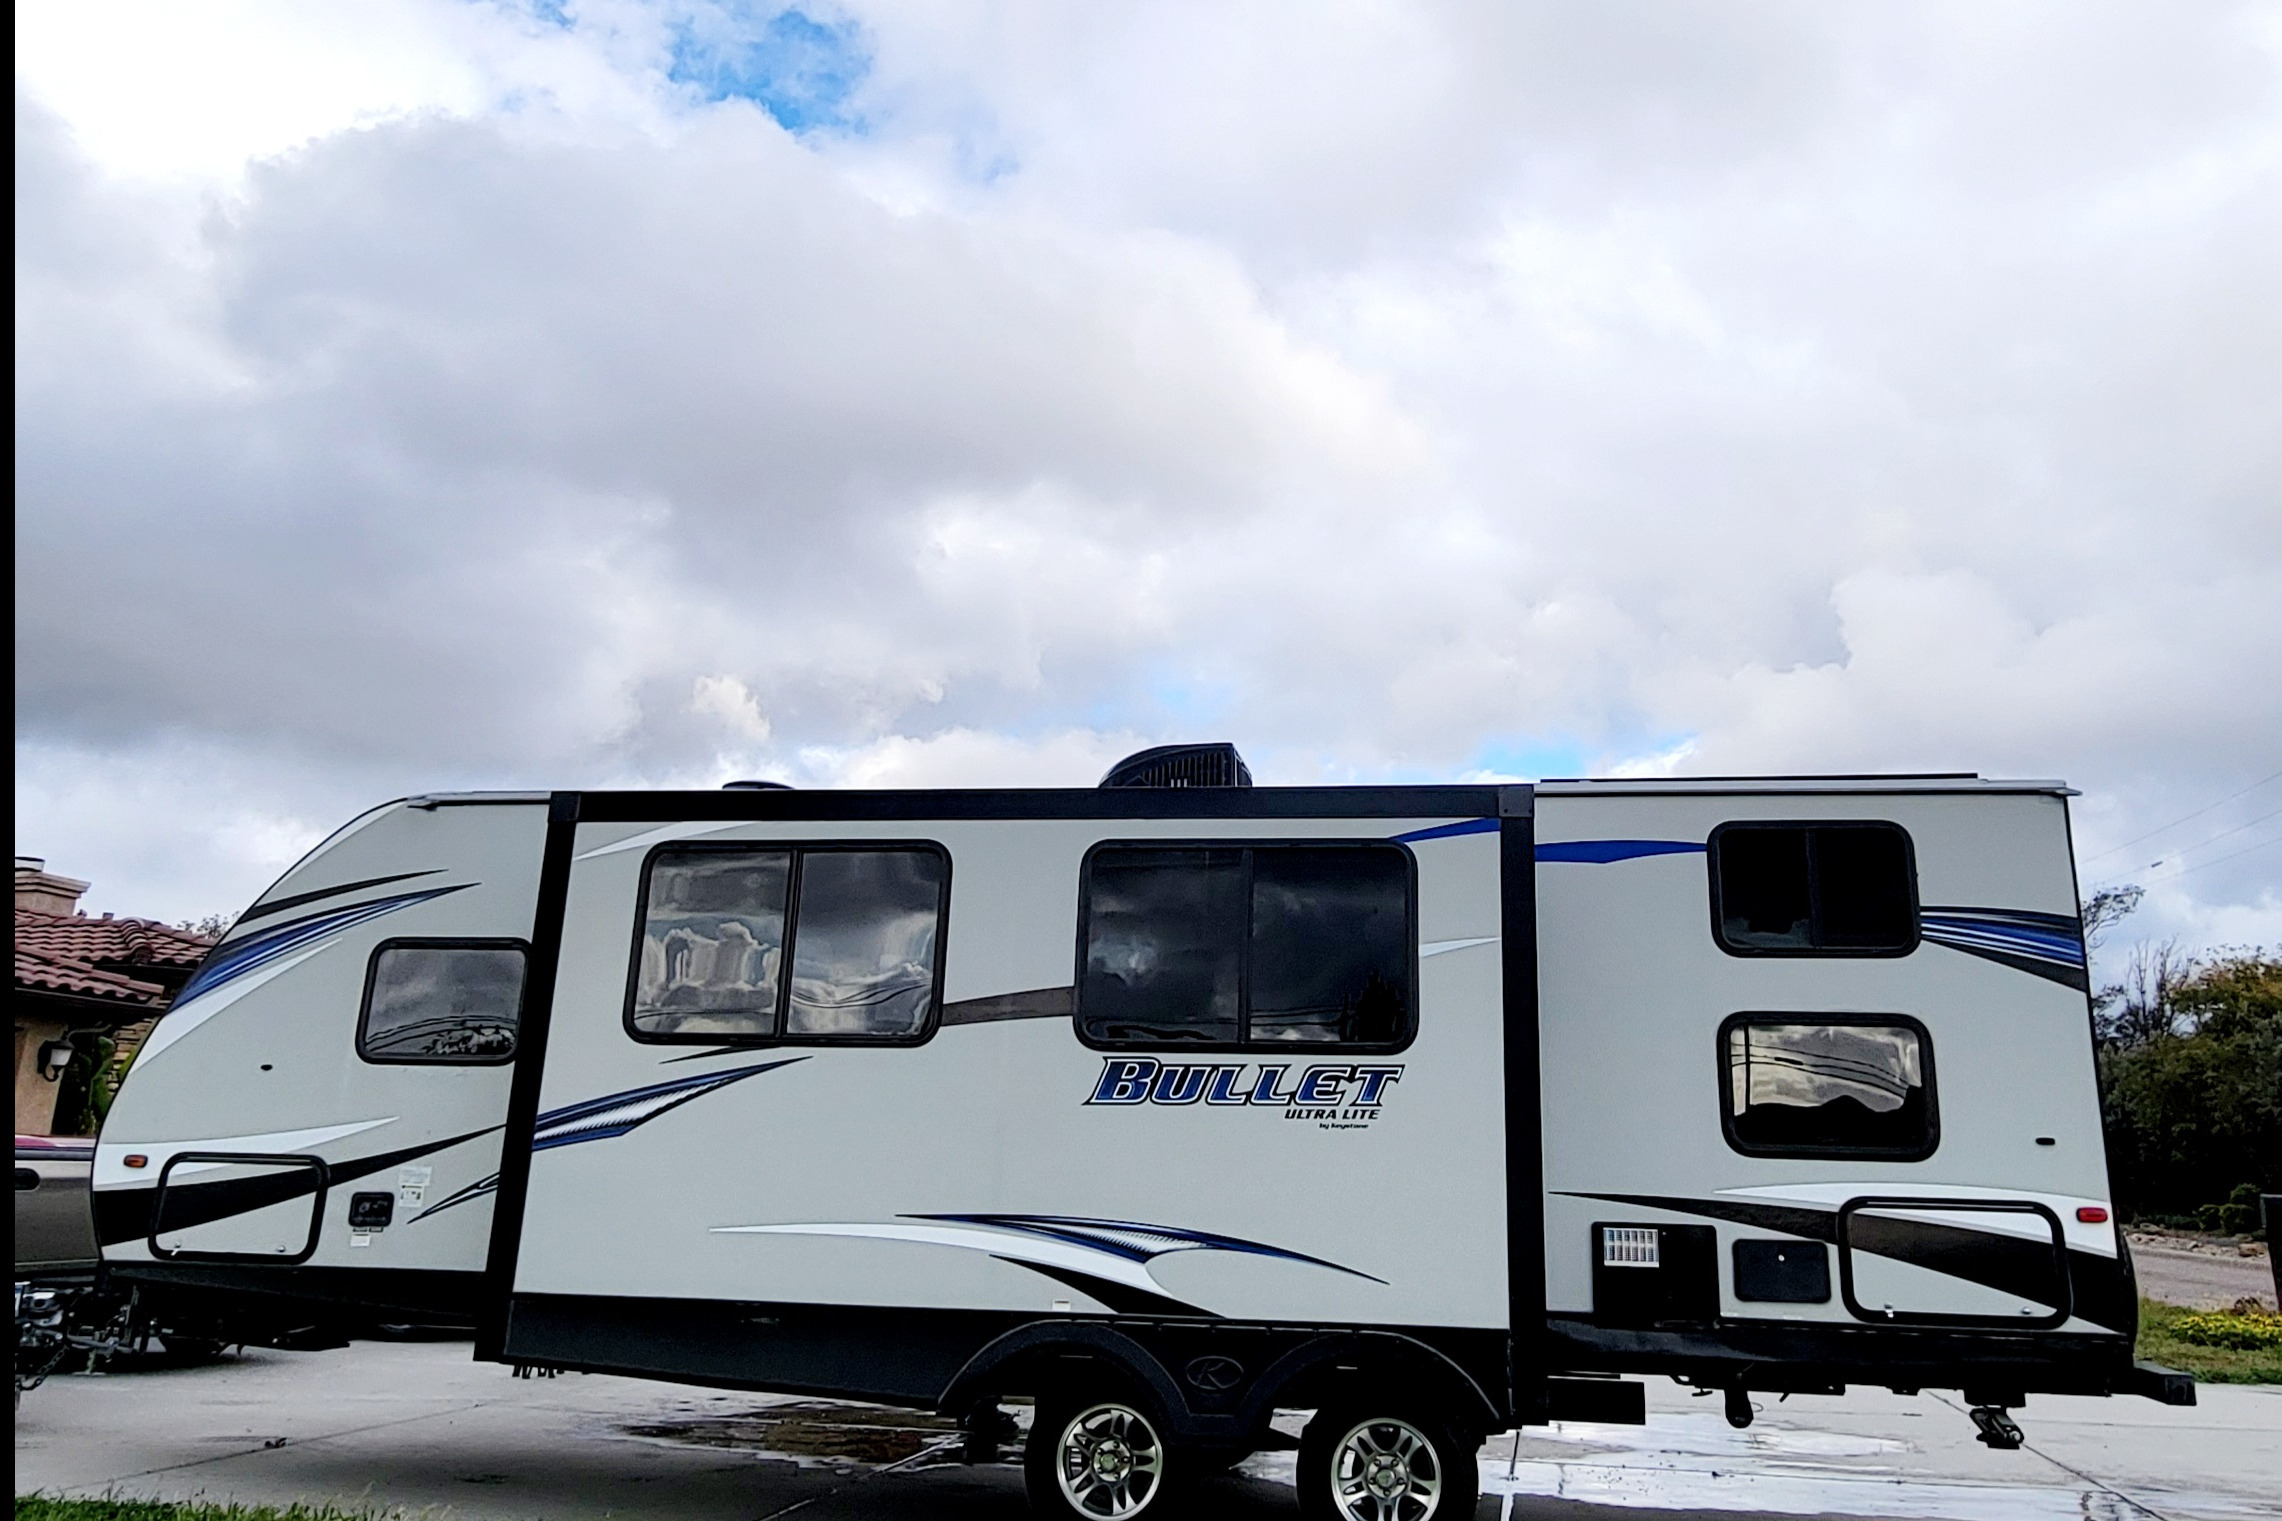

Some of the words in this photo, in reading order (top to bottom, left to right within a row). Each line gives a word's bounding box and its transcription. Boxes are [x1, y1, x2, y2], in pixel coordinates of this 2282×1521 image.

[1082, 1056, 1405, 1106] BULLET
[1284, 1108, 1337, 1120] ULTRA
[1341, 1108, 1381, 1120] LITE
[1319, 1122, 1330, 1130] by
